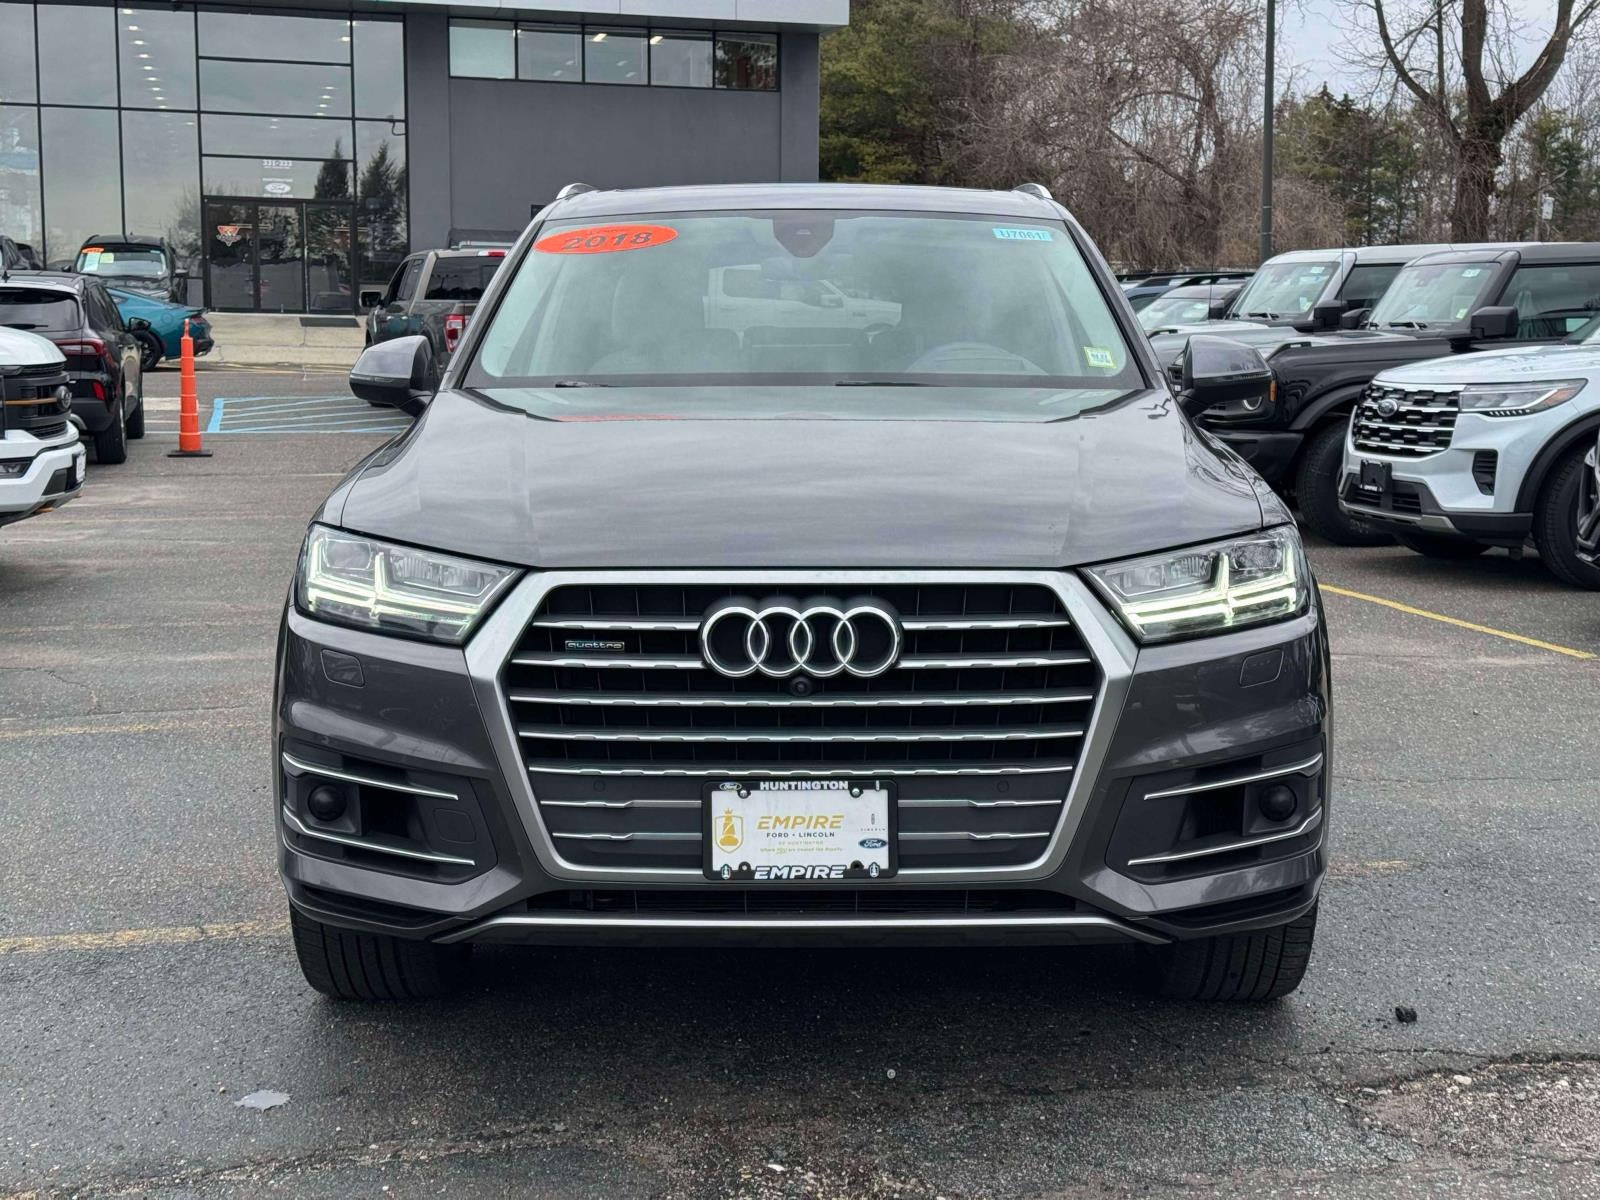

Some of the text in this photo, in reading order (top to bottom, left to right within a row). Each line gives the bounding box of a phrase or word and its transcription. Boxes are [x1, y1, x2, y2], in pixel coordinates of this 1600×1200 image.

[561, 232, 653, 250] 2018
[760, 781, 848, 790] HUNTINGTON
[757, 815, 844, 830] EMPIRE
[754, 866, 846, 879] EMPIRE
